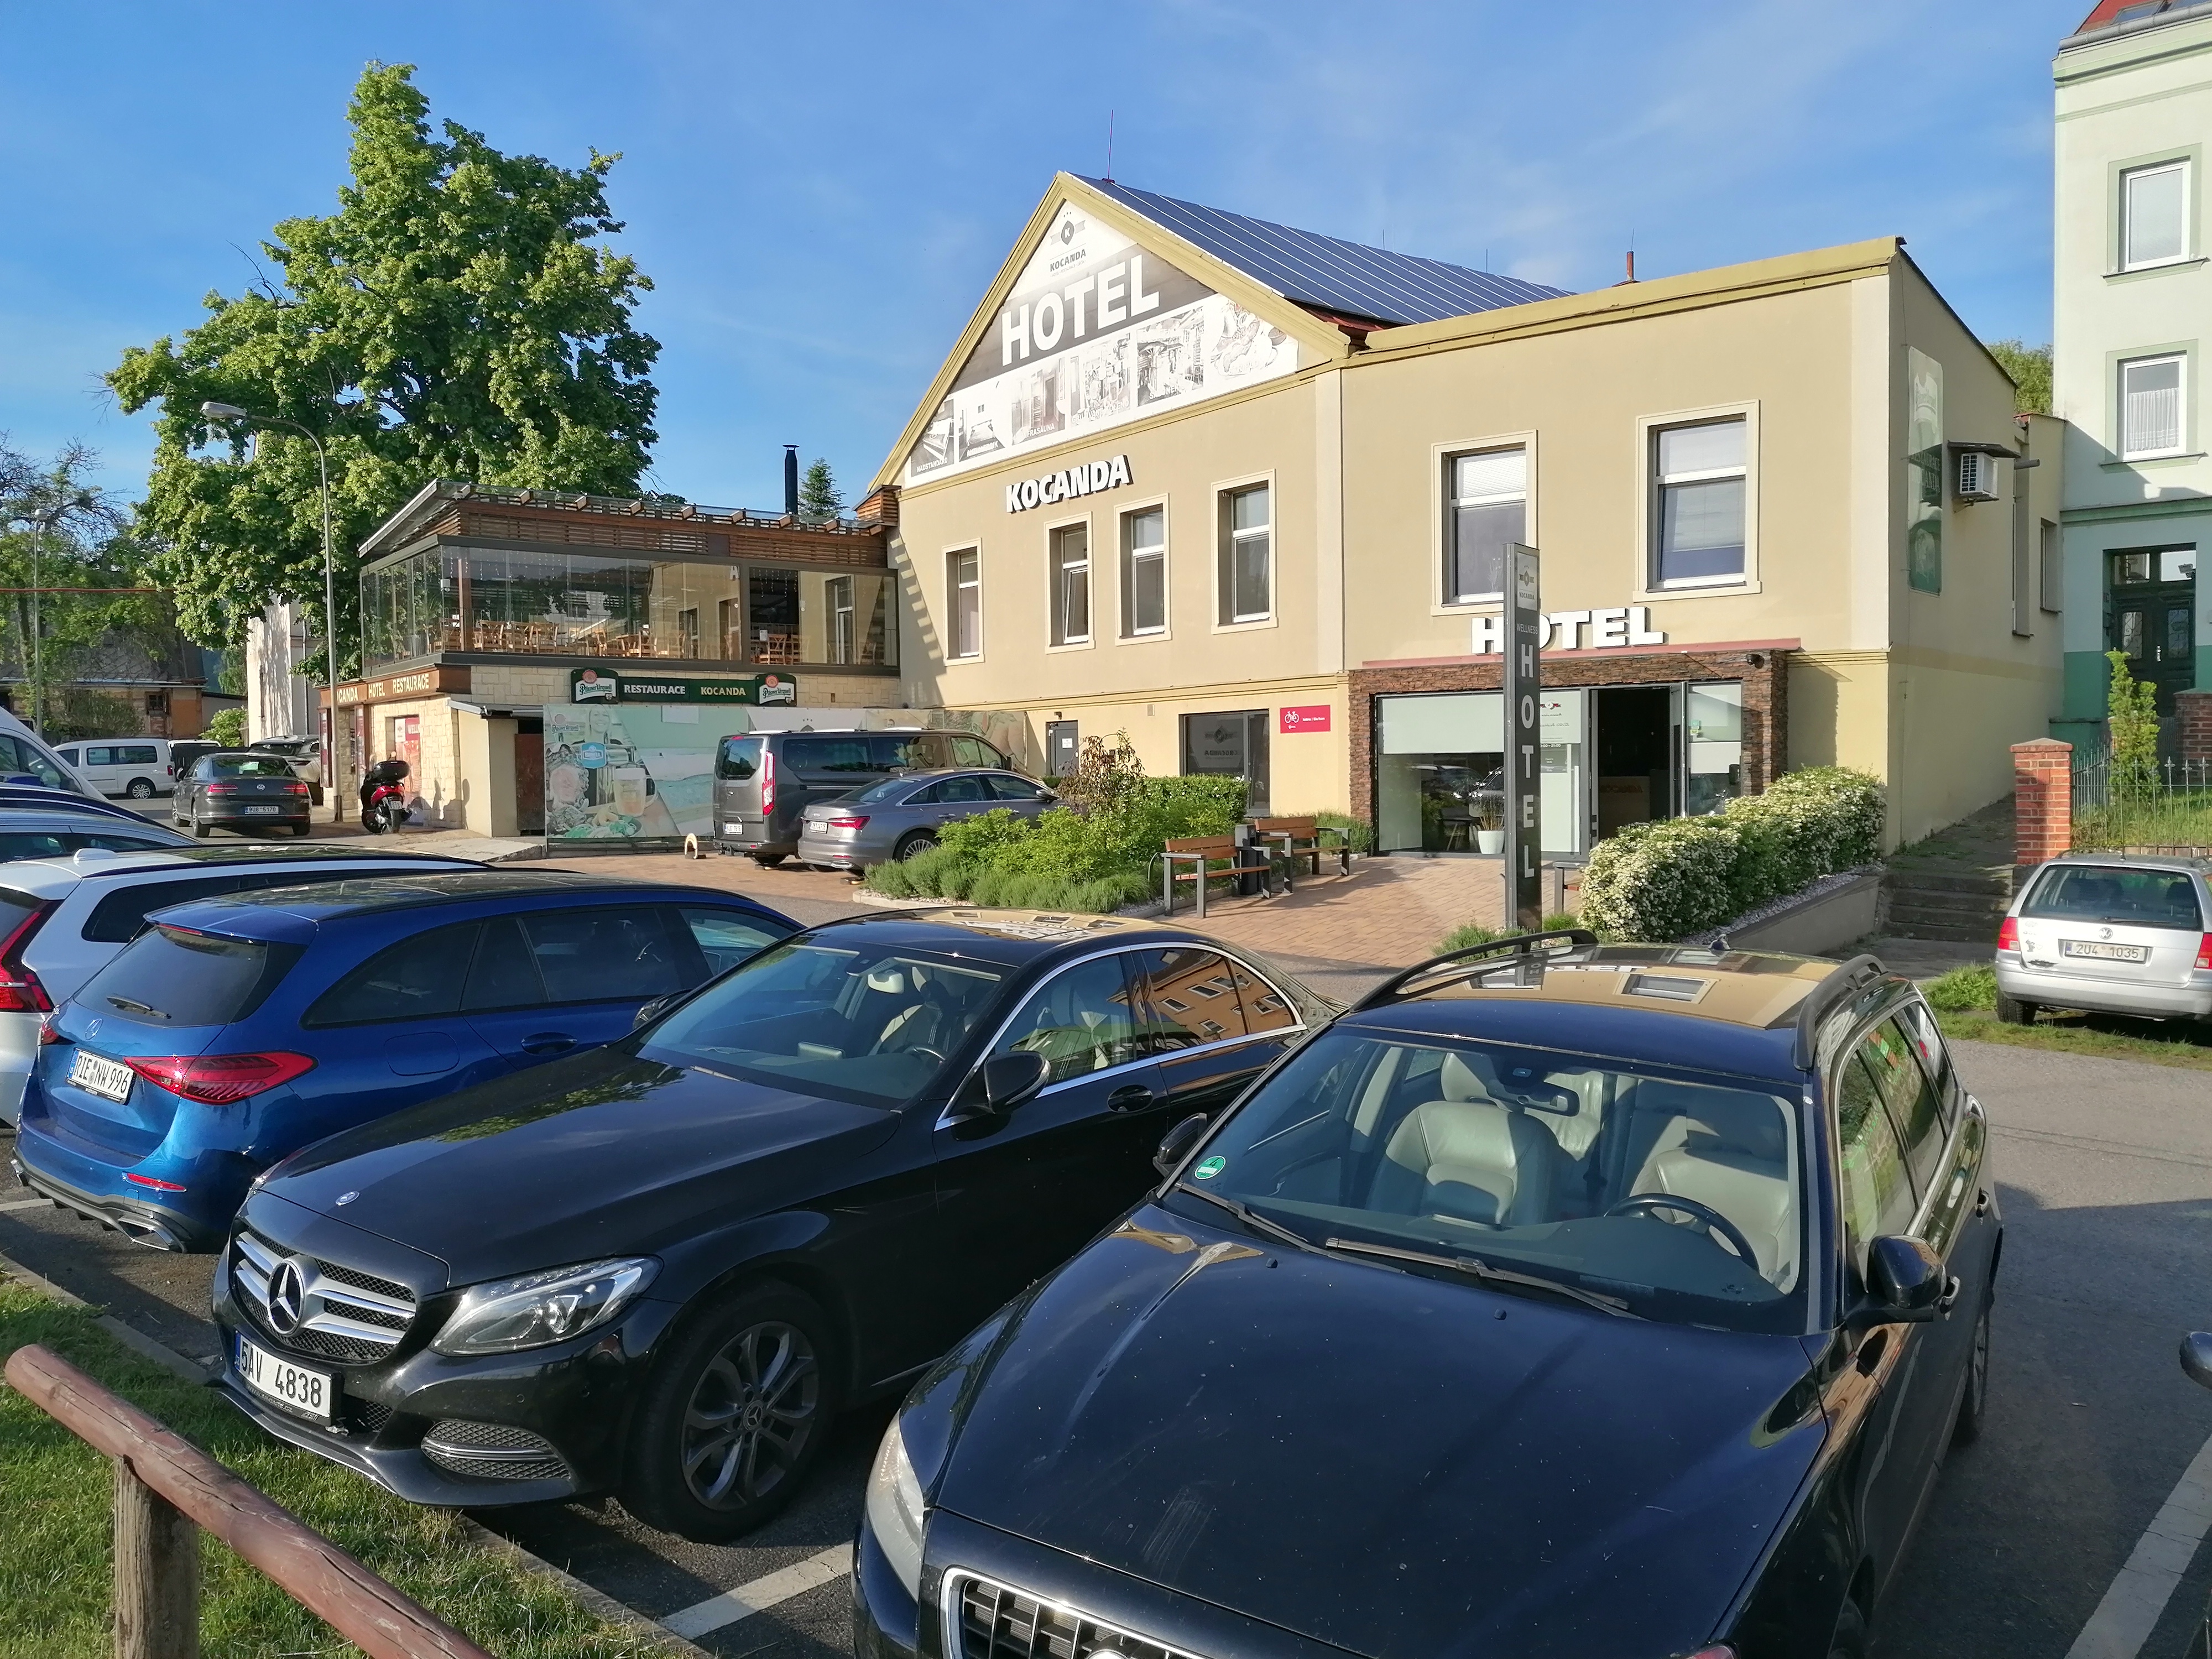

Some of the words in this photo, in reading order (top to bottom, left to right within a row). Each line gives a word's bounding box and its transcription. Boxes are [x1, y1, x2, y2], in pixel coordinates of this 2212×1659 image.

[1065, 227, 1071, 238] K
[1050, 249, 1086, 272] KOCANDA
[1002, 254, 1159, 366] HOTEL
[1006, 454, 1131, 513] KOCANDA
[1472, 606, 1665, 655] HTEL
[1516, 623, 1538, 635] WELLNESS
[368, 682, 385, 698] HOTEL
[393, 674, 429, 695] RESTAURACE
[580, 684, 597, 695] Pilsner
[597, 684, 612, 692] Urquell
[624, 685, 686, 695] RESTAURACE
[701, 687, 746, 696] KOCANDA
[763, 687, 778, 698] Pilsner
[1521, 643, 1535, 878] HOTEL
[2076, 944, 2099, 956] 2U4
[2110, 946, 2139, 959] 1035
[74, 1055, 92, 1080] RIE
[108, 1068, 130, 1094] 996
[1209, 1157, 1220, 1167] 4
[242, 1341, 263, 1383] 5AV
[275, 1364, 322, 1408] 4838
